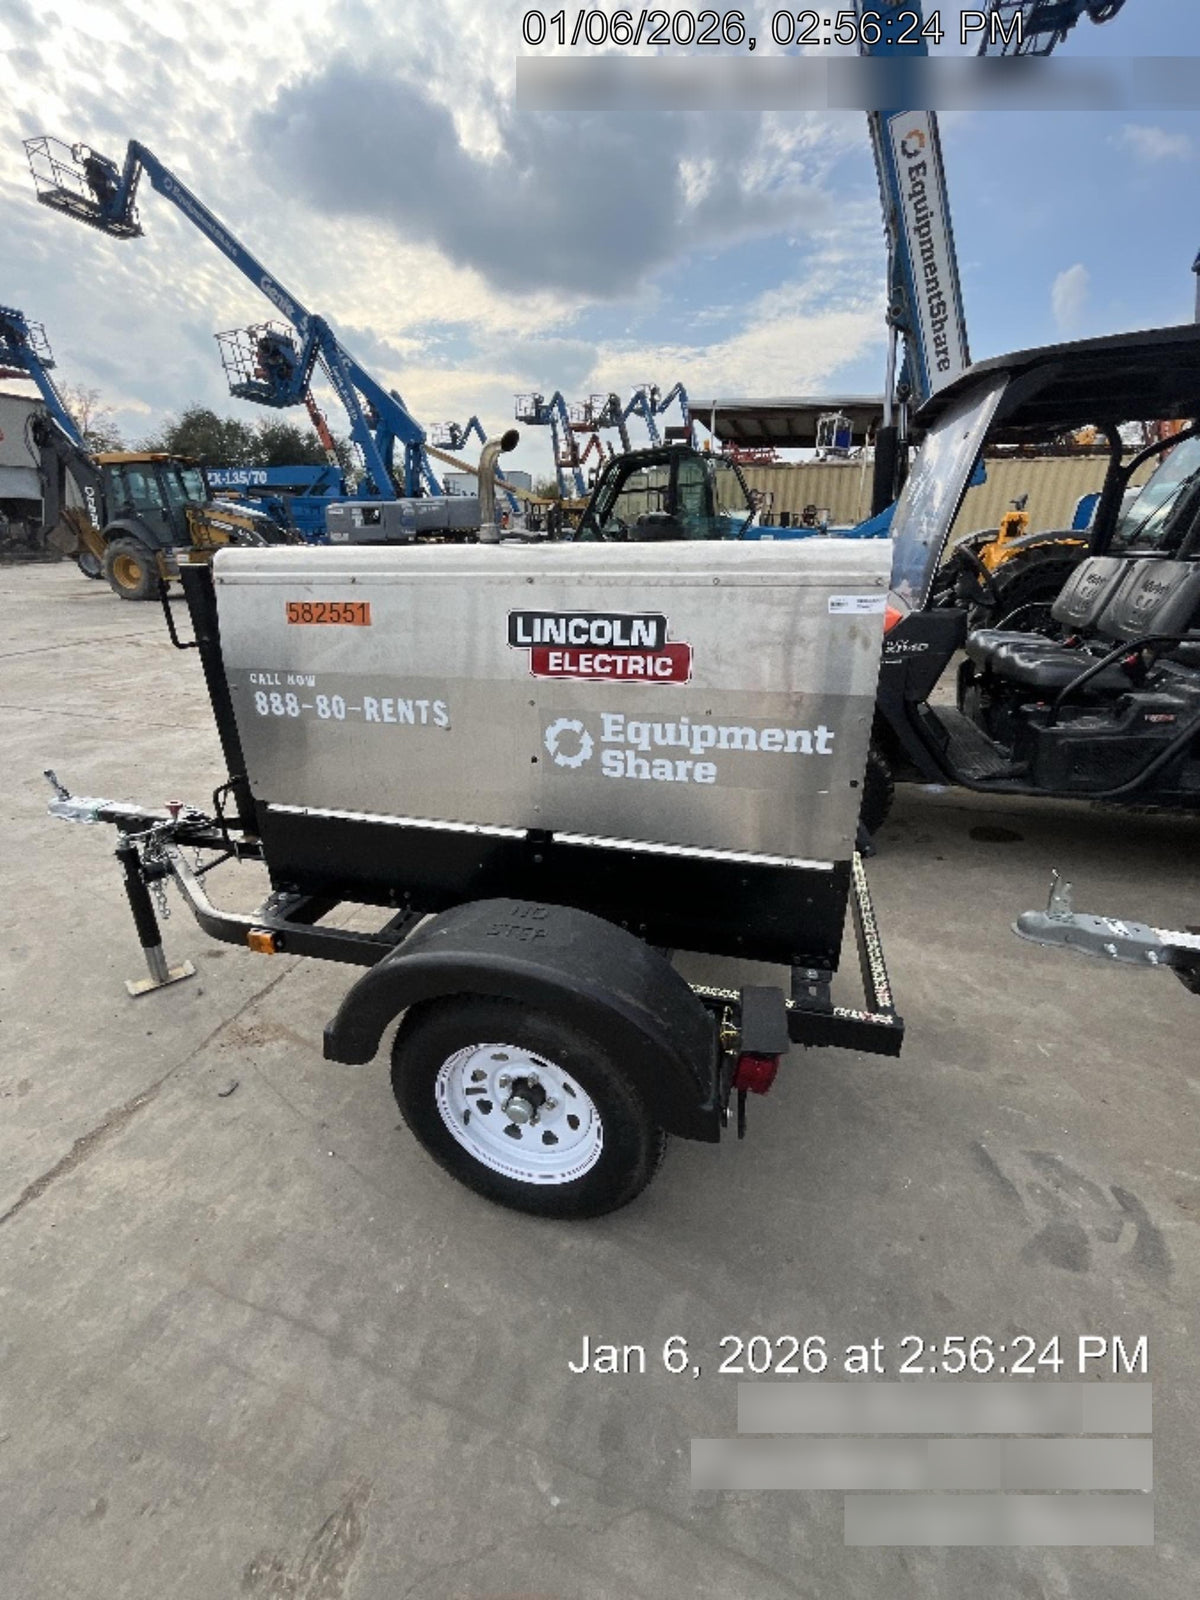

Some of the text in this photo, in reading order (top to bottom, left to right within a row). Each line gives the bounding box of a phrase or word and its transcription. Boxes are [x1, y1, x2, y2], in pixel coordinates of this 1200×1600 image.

[908, 160, 950, 373] EquipmentShare
[288, 602, 368, 623] 582551
[516, 616, 657, 647] LINCOLN
[250, 673, 316, 687] CALL NOW
[549, 652, 673, 676] ELECTRIC
[254, 690, 450, 728] 888-80-RENTS
[600, 712, 835, 755] Equipment
[600, 749, 718, 784] Share
